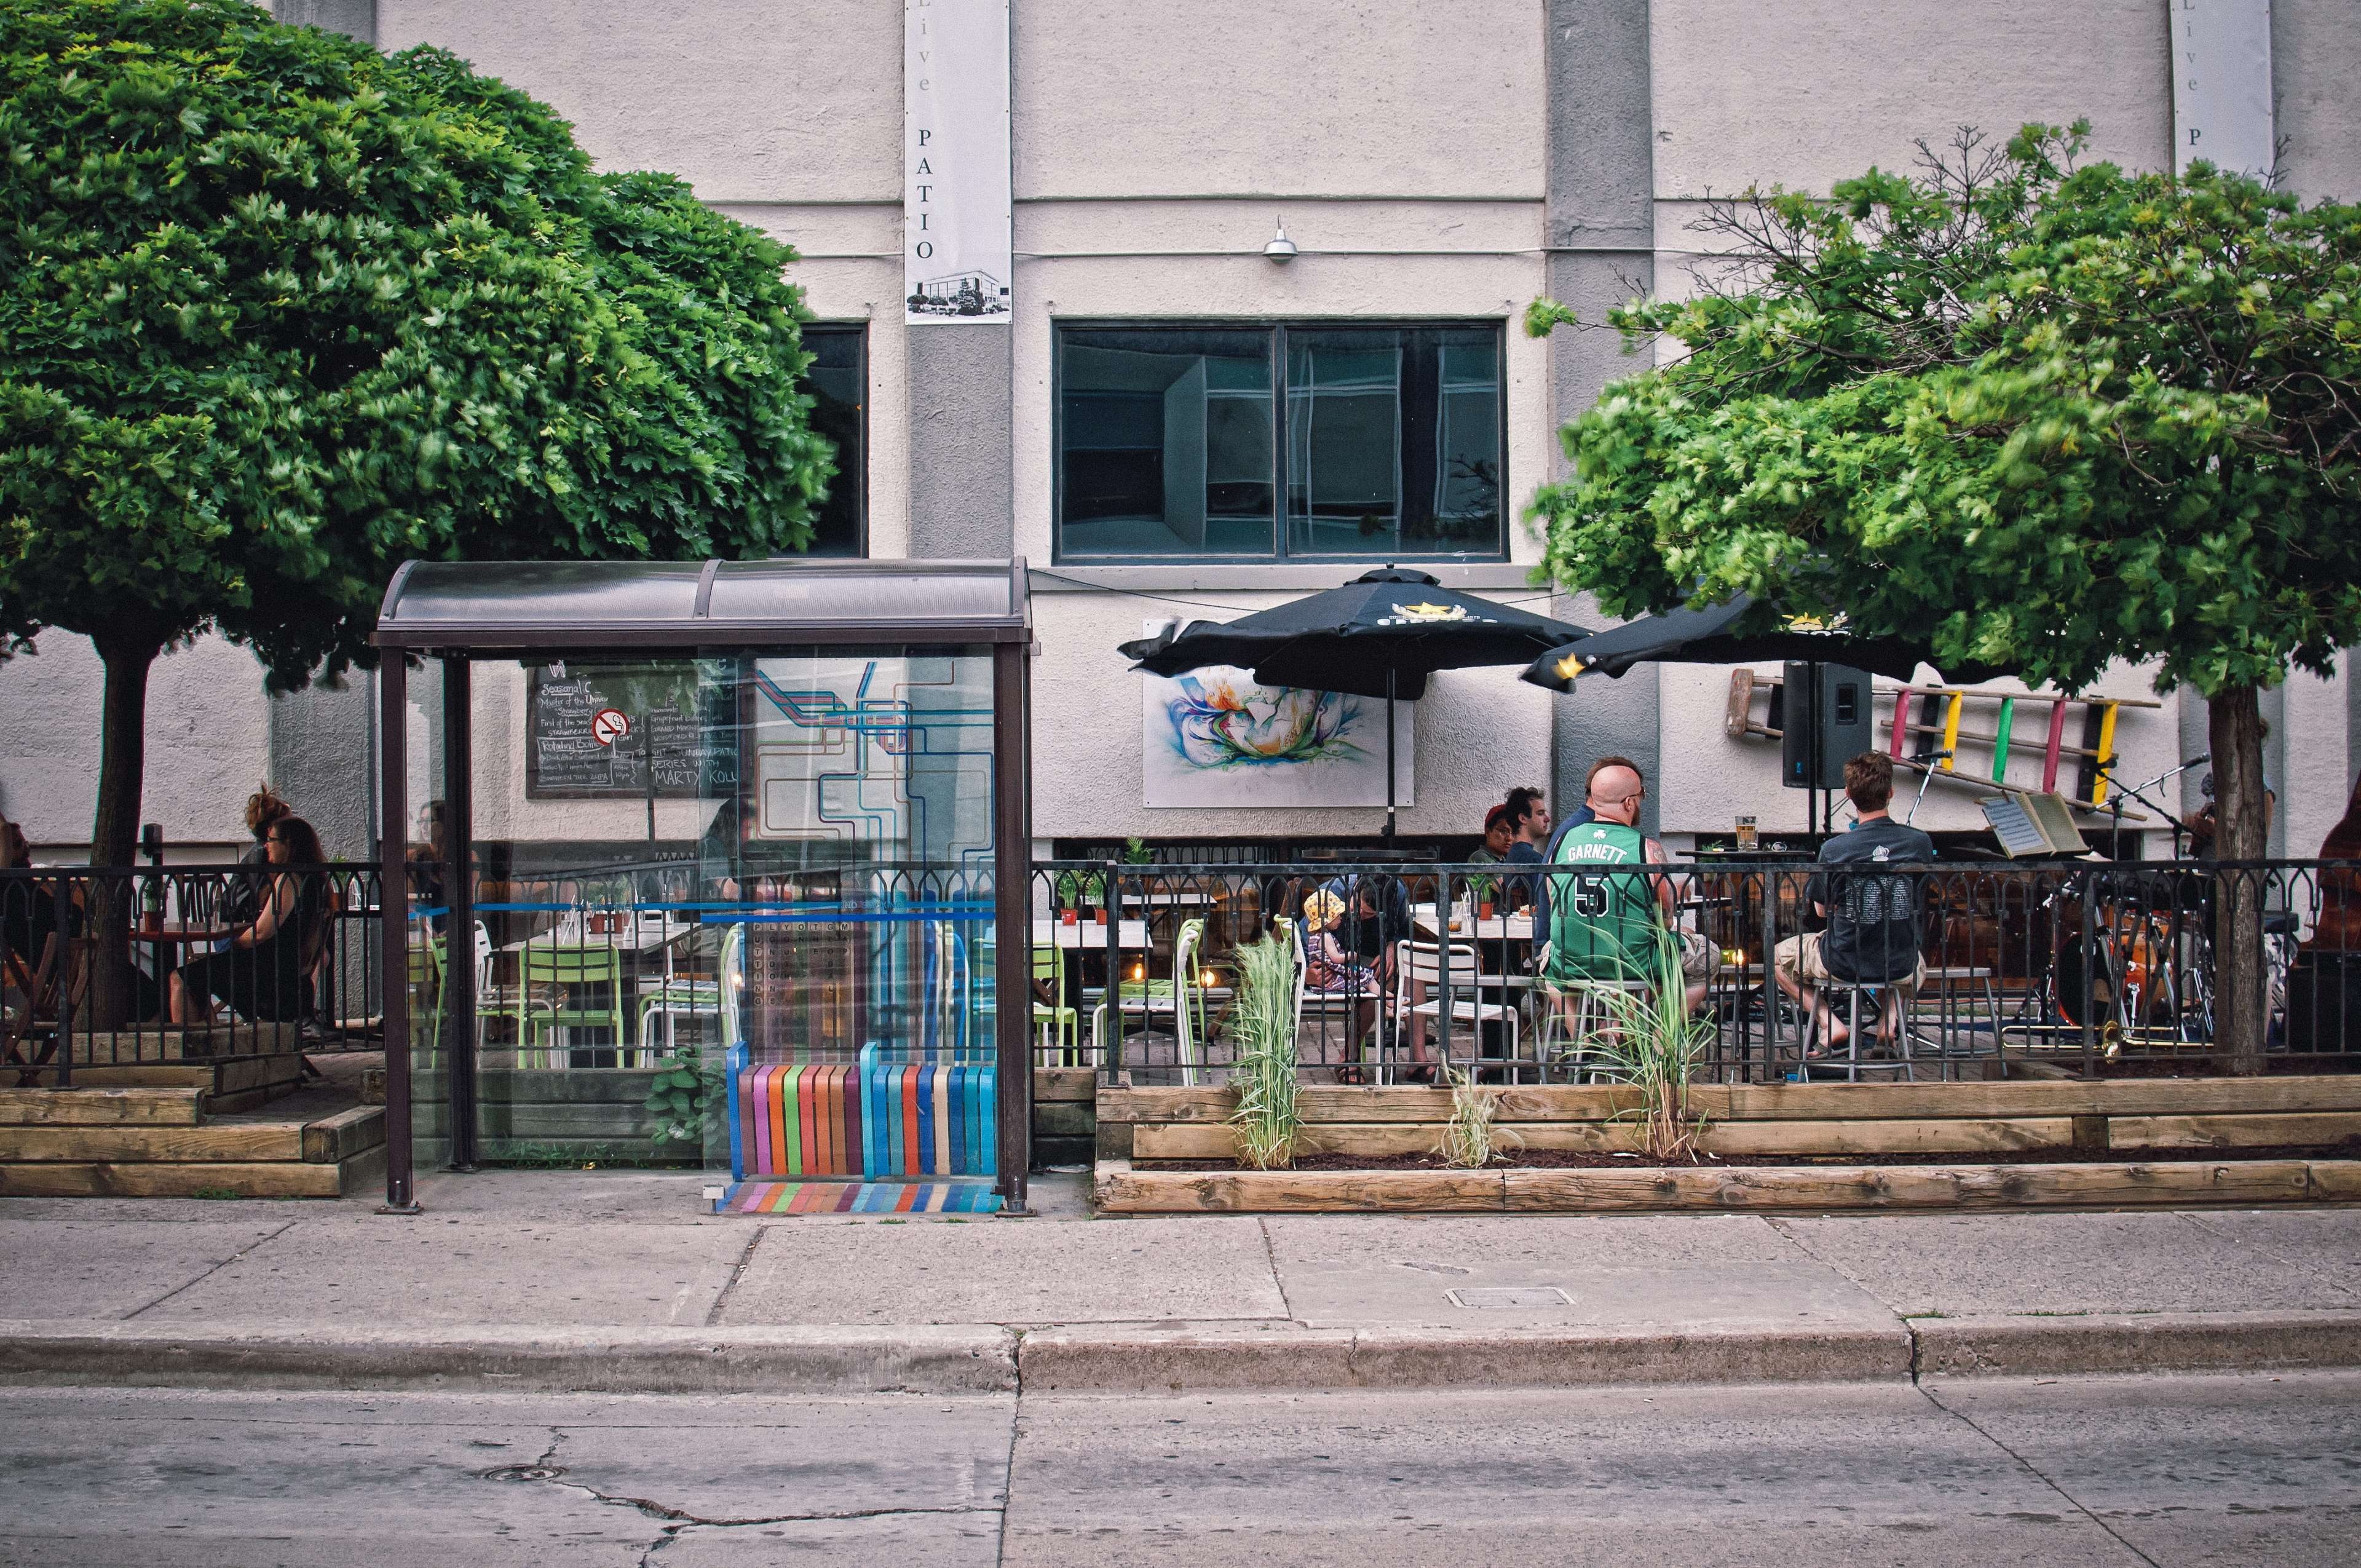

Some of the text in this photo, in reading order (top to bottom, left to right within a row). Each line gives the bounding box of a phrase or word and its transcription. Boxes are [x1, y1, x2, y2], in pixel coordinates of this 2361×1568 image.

[916, 129, 933, 259] PATIO
[541, 679, 582, 696] Seasonal
[652, 759, 687, 769] SERIES
[655, 770, 699, 786] MARTY
[1568, 843, 1628, 865] GARNETT
[1574, 876, 1609, 917] 5
